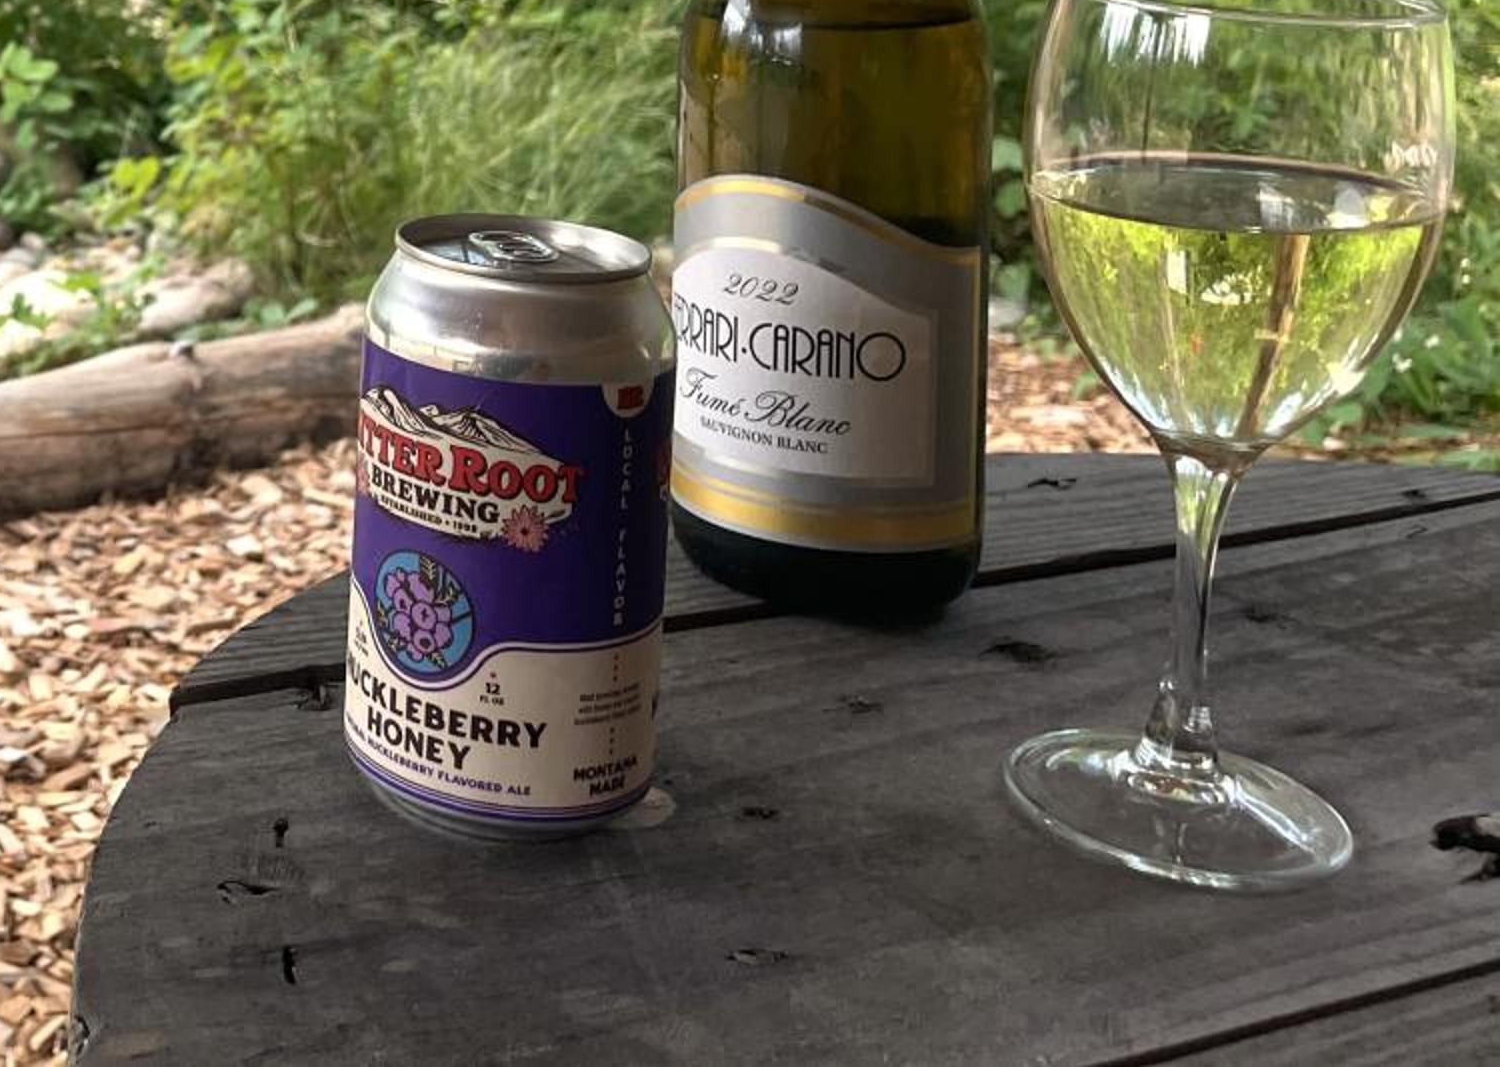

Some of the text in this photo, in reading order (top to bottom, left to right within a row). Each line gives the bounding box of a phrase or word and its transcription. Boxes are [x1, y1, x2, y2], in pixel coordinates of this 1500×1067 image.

[723, 273, 800, 306] 2022
[679, 366, 741, 418] Fumé
[744, 389, 852, 436] Blanc
[700, 415, 829, 455] SAUVIGNON BLANC
[371, 463, 500, 524] BREWING
[449, 444, 585, 504] ROOT
[485, 681, 501, 696] 12
[367, 705, 471, 771] HONEY
[367, 734, 531, 796] HUCKLEBERRY FLAVORED ALE
[573, 755, 638, 781] MONTANA
